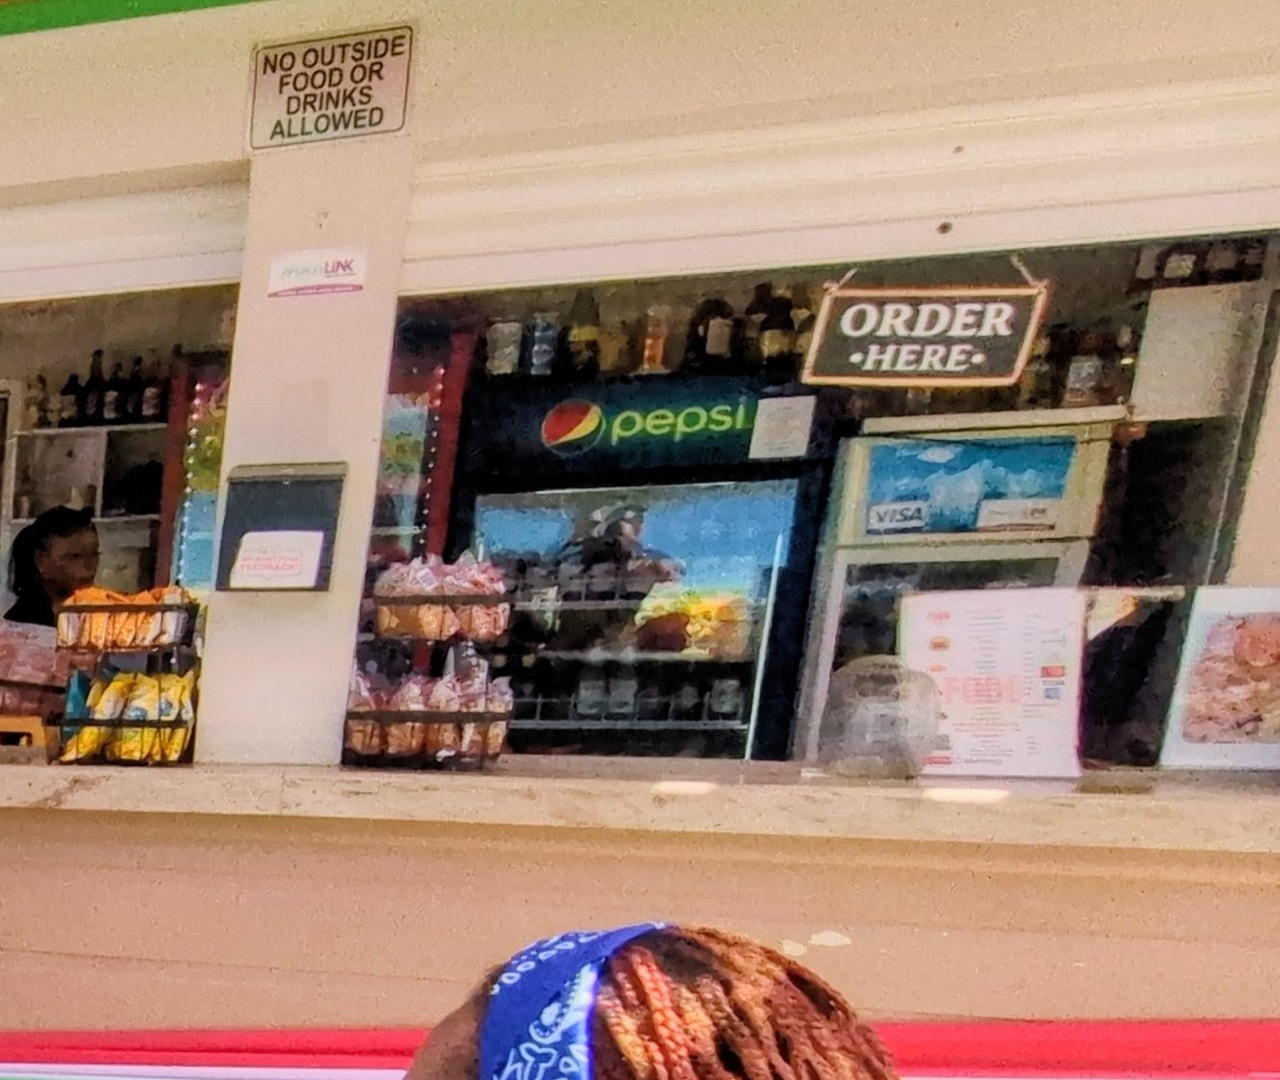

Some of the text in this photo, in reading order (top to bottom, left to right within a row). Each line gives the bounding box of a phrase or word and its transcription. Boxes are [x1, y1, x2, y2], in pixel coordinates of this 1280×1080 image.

[262, 35, 406, 75] NO OUTSIDE
[279, 62, 384, 94] FOOD OR
[286, 86, 373, 115] DRINKS
[269, 107, 384, 140] ALLOWED
[840, 302, 1017, 338] ORDER
[611, 396, 746, 446] pepsi
[875, 507, 923, 523] VISA
